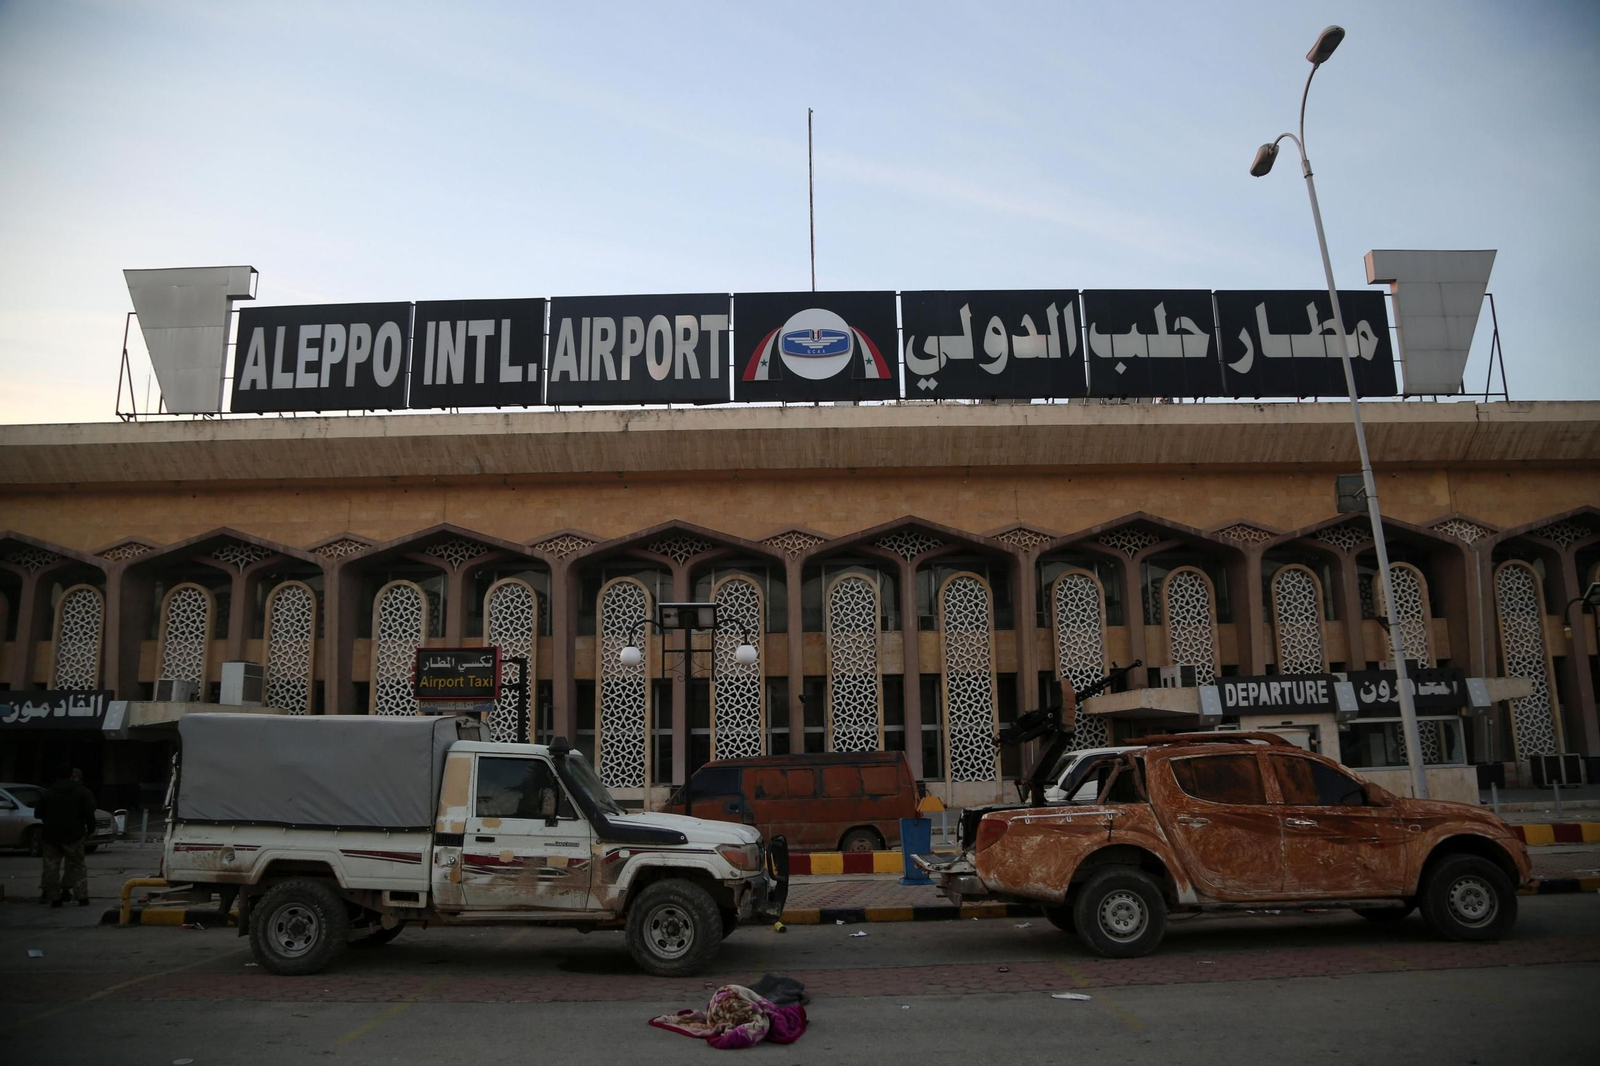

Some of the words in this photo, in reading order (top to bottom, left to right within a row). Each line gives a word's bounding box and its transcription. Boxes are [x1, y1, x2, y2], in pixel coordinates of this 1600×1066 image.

[238, 320, 402, 391] ALEPPO
[423, 319, 538, 387] INTL.
[550, 313, 729, 383] AIRPORT
[904, 300, 1077, 392] الدولي
[1089, 300, 1211, 375] حلب
[1227, 301, 1380, 374] مطار
[423, 657, 455, 671] المطار
[457, 655, 493, 673] تكسي
[420, 676, 464, 690] Airport
[468, 675, 493, 688] Taxi
[1224, 679, 1329, 708] DEPARTURE
[2, 693, 104, 724] القادمون
